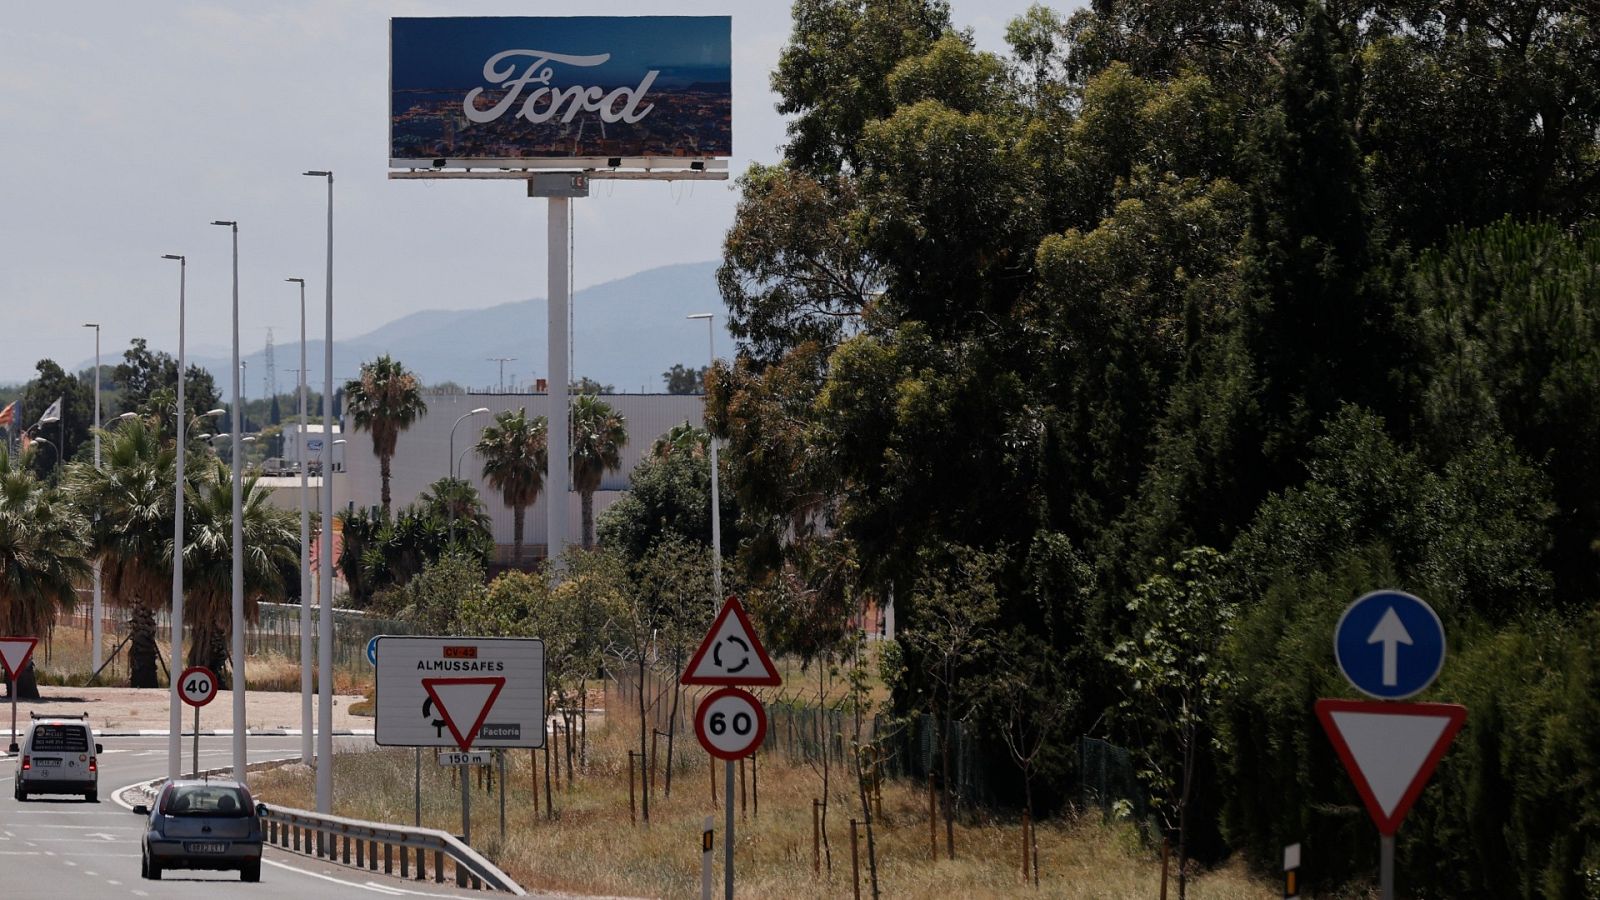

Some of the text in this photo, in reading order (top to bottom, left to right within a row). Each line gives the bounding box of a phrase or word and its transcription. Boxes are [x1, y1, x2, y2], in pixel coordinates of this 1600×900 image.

[463, 49, 659, 123] Ford
[417, 660, 504, 671] ALMUSSAFES
[185, 679, 210, 694] 40
[709, 711, 752, 735] 60
[449, 754, 482, 764] 150 m
